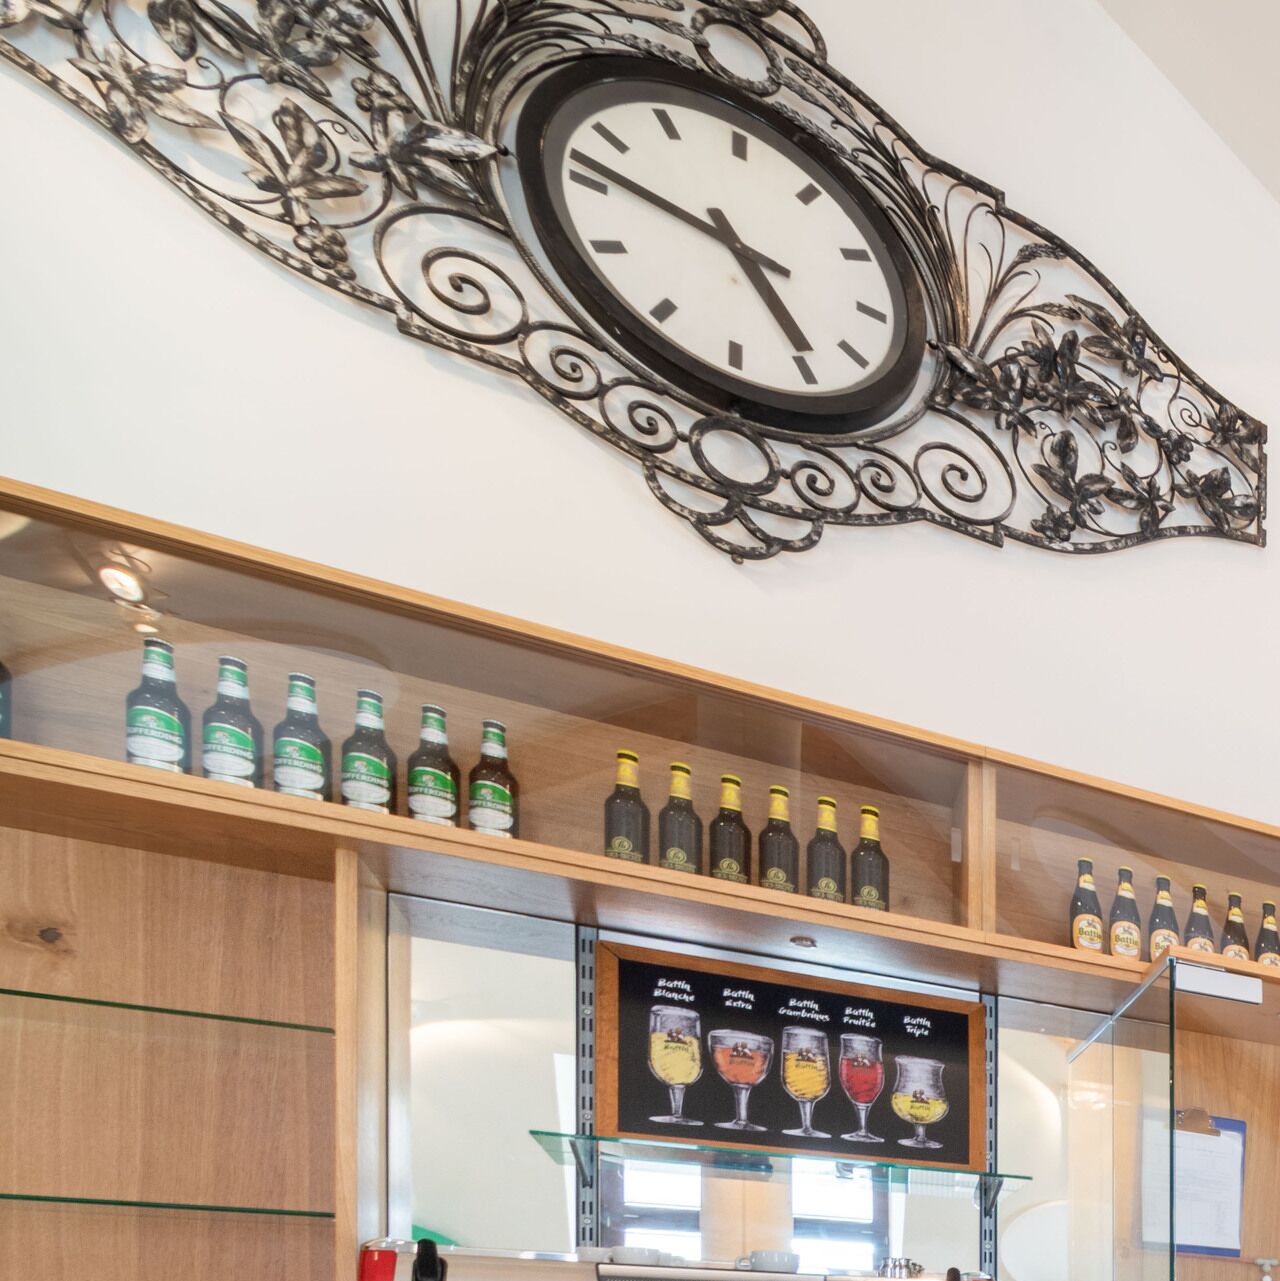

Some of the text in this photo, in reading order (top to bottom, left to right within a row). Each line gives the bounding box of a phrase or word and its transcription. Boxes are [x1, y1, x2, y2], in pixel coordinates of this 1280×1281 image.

[657, 978, 692, 992] Battin
[653, 988, 695, 1003] Blanche
[722, 988, 756, 1002] Battin
[724, 1000, 753, 1010] Extra
[788, 998, 819, 1012] Battin
[778, 1006, 831, 1022] Gambrinus
[844, 1007, 875, 1020] Battin
[903, 1015, 932, 1029] Battin
[905, 1025, 930, 1037] Triple
